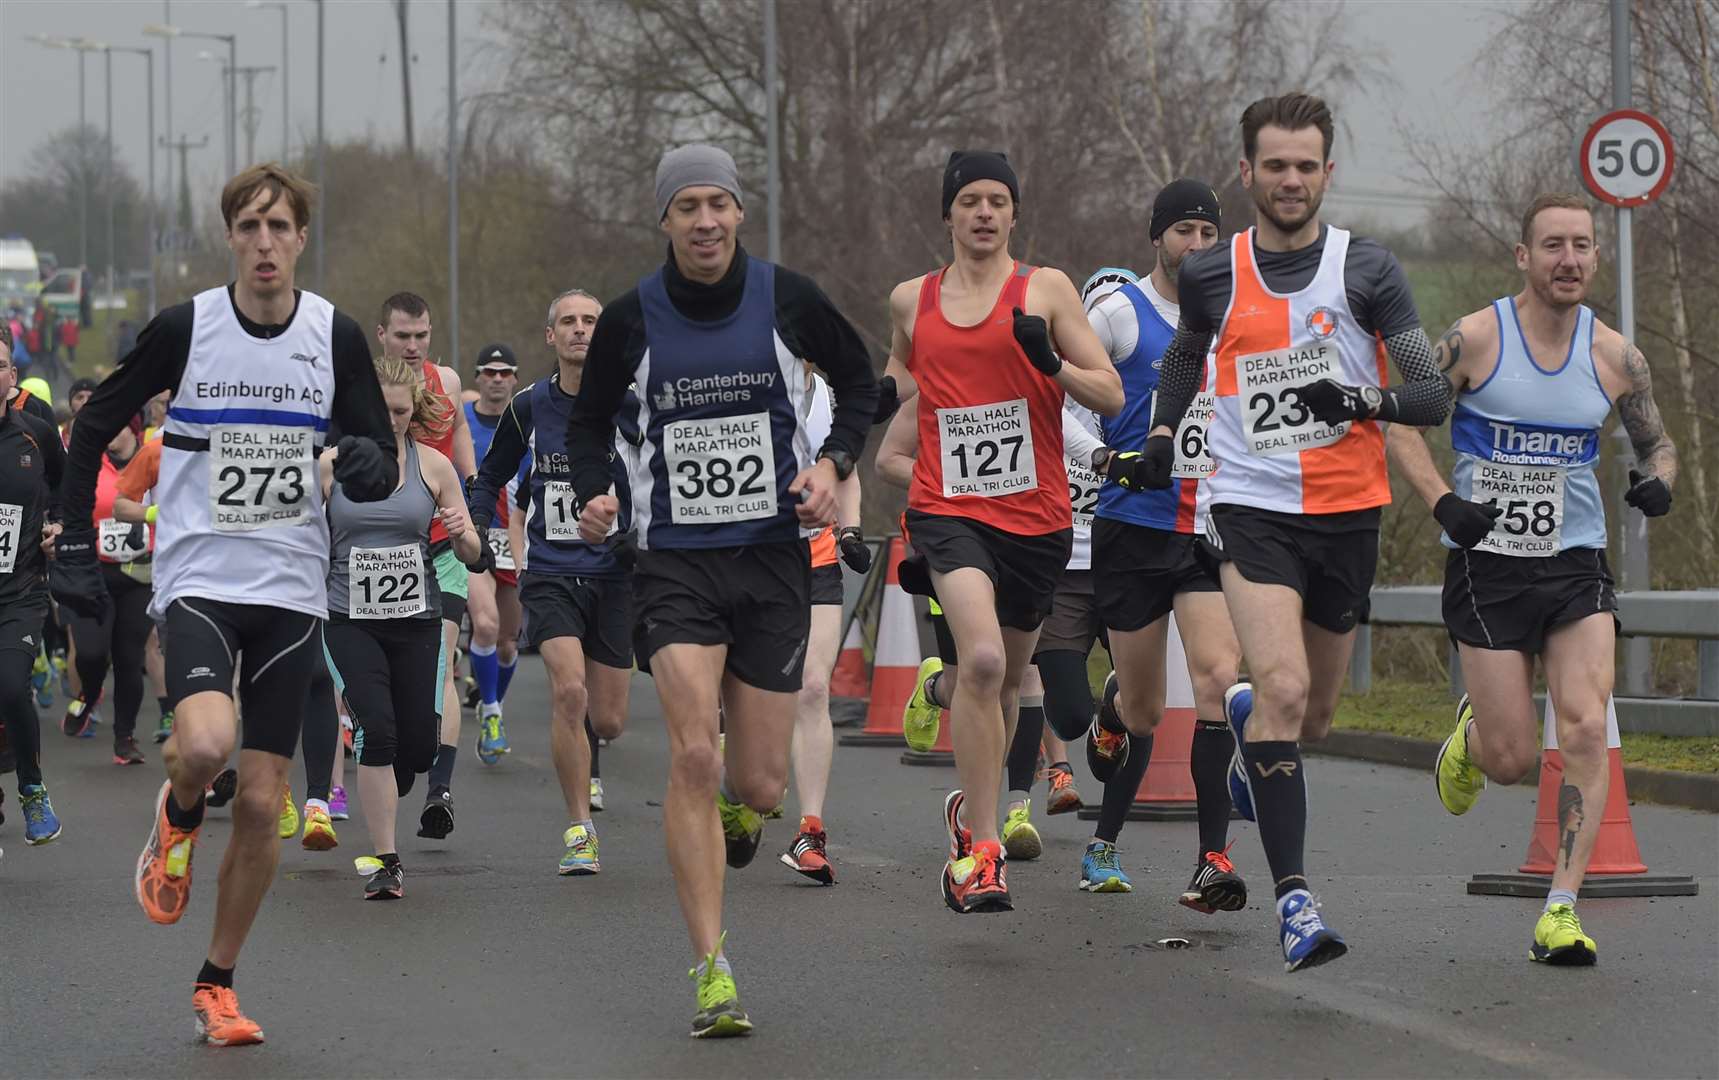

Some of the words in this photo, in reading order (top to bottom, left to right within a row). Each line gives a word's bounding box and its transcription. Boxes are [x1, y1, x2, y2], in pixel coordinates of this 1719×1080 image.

[1597, 138, 1660, 178] 50
[1245, 356, 1283, 373] DEAL
[1288, 346, 1327, 365] HALF
[676, 371, 777, 392] Canterbury
[1247, 361, 1330, 387] MARATHON
[197, 381, 295, 403] Edinburgh
[300, 387, 323, 405] AC
[678, 389, 752, 408] Harriers
[945, 412, 979, 425] DEAL
[984, 405, 1019, 420] HALF
[1249, 387, 1310, 434] 23
[673, 426, 713, 440] DEAL
[720, 420, 760, 436] HALF
[948, 419, 1021, 438] MARATHON
[1255, 437, 1288, 451] DEAL
[1291, 432, 1310, 444] TRI
[1314, 425, 1345, 440] CLUB
[1489, 421, 1587, 455] Thanet
[221, 432, 262, 444] DEAL
[269, 432, 306, 445] HALF
[674, 435, 761, 454] MARATHON
[221, 447, 304, 459] MARATHON
[951, 434, 1024, 478] 127
[676, 455, 766, 499] 382
[1067, 468, 1105, 484] MARAT
[1182, 464, 1197, 472] TRI
[1482, 467, 1516, 481] DEAL
[1523, 471, 1557, 482] HALF
[218, 466, 305, 506] 273
[951, 484, 980, 494] DEAL
[983, 481, 999, 491] TRI
[1003, 475, 1030, 489] CLUB
[1481, 480, 1555, 495] MARATHON
[1068, 482, 1100, 514] 22
[218, 513, 250, 523] DEAL
[253, 512, 270, 522] TRI
[272, 509, 302, 520] CLUB
[680, 506, 711, 516] DEAL
[714, 505, 733, 515] TRI
[737, 500, 769, 513] CLUB
[552, 527, 574, 535] DEAL
[0, 531, 11, 557] 4
[104, 533, 128, 552] 37
[488, 539, 513, 558] 32
[1481, 537, 1503, 548] EAL
[1507, 540, 1522, 550] TRI
[1525, 542, 1553, 551] CLUB
[355, 553, 384, 562] DEAL
[389, 549, 415, 560] HALF
[356, 559, 416, 571] MARATHON
[357, 573, 419, 603] 122
[382, 607, 395, 615] TRI
[398, 604, 420, 613] CLUB
[1255, 761, 1297, 778] VR
